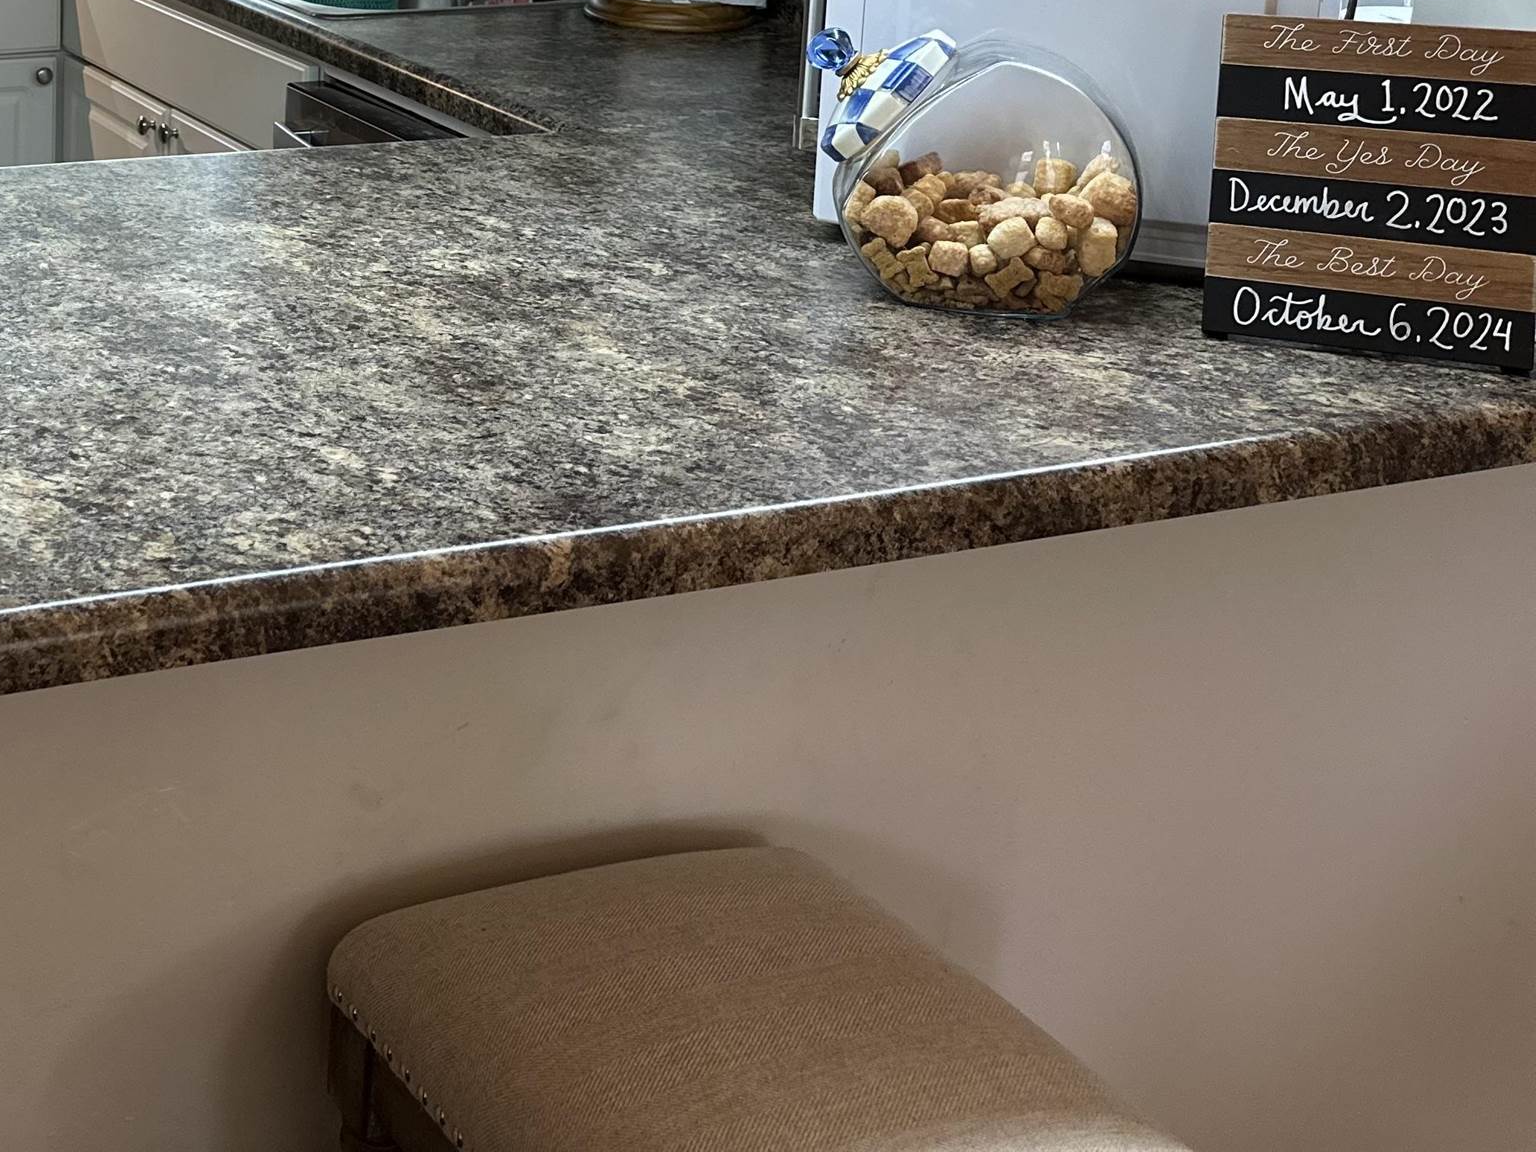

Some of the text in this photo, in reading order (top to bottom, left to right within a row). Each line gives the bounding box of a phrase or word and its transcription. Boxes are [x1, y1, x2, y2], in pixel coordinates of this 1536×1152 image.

[1264, 23, 1505, 76] The First Day
[1284, 76, 1397, 124] May
[1267, 131, 1486, 187] The Yes Day
[1229, 177, 1375, 222] December
[1246, 239, 1490, 300] The Best Day
[1233, 286, 1382, 336] October
